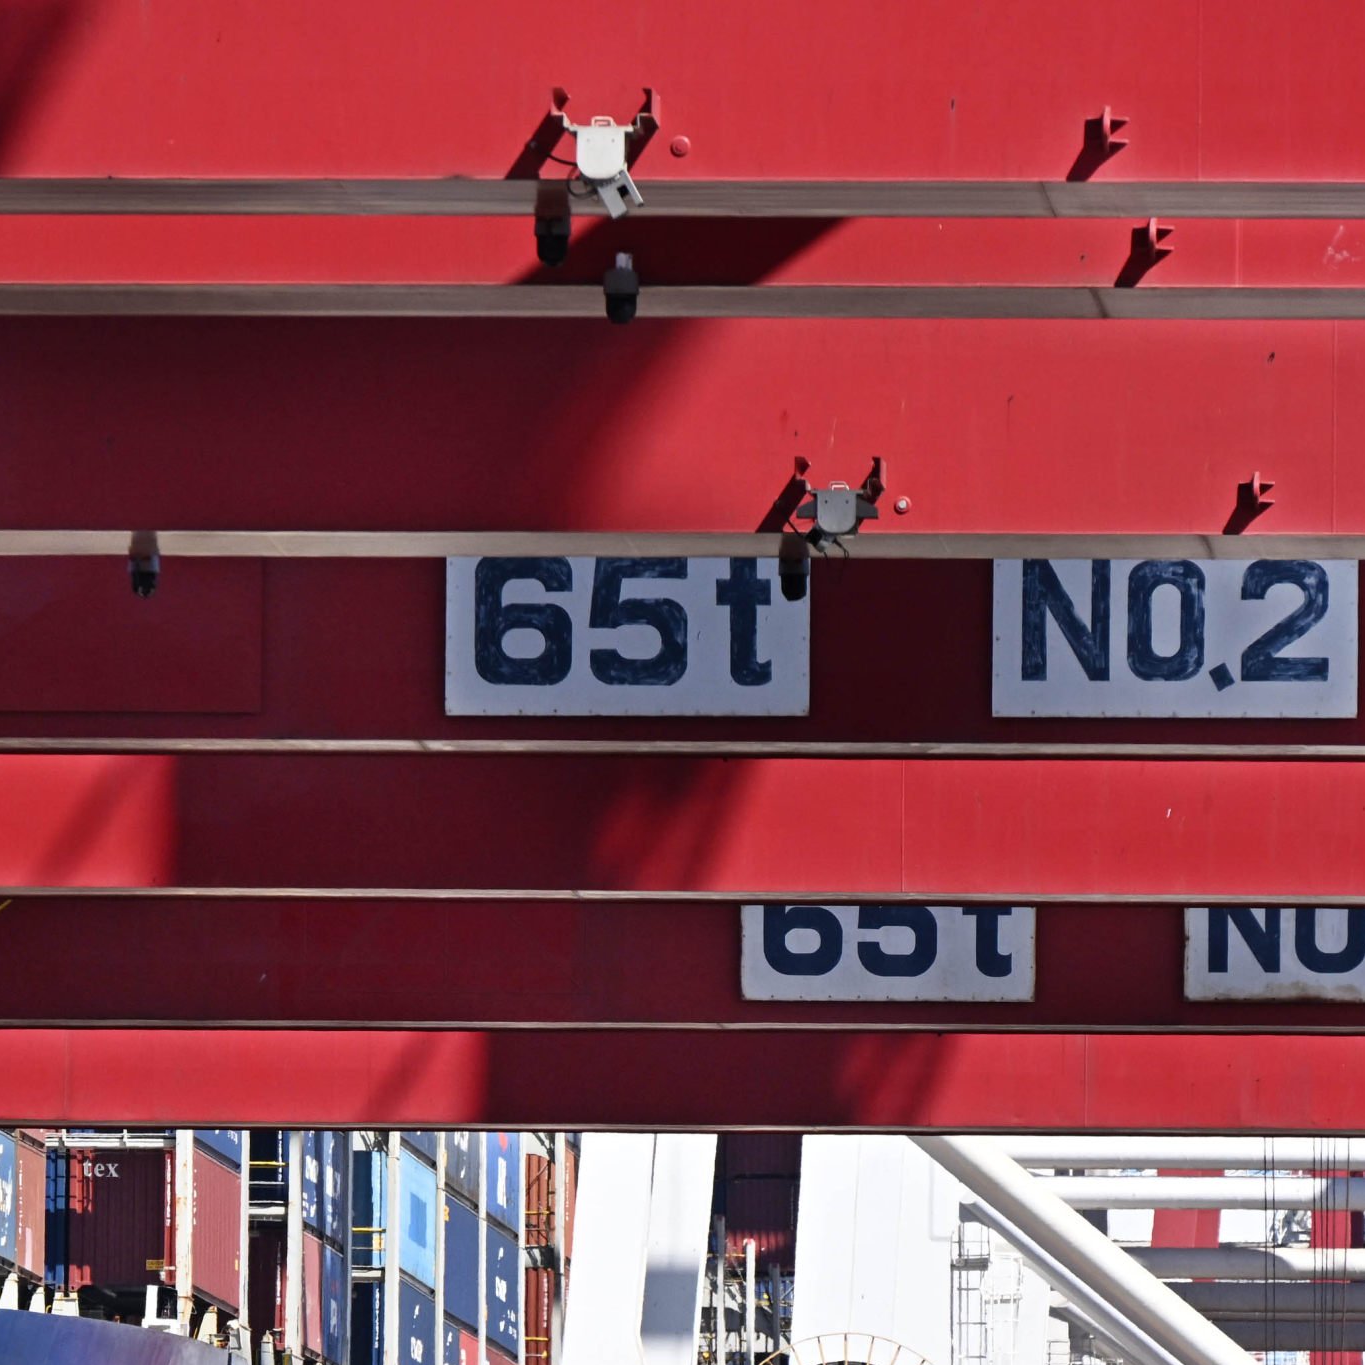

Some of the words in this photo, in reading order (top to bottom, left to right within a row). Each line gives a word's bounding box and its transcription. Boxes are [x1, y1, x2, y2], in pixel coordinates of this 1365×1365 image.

[474, 556, 773, 686] 65t
[761, 905, 1013, 978] 65t
[82, 1158, 120, 1178] tex
